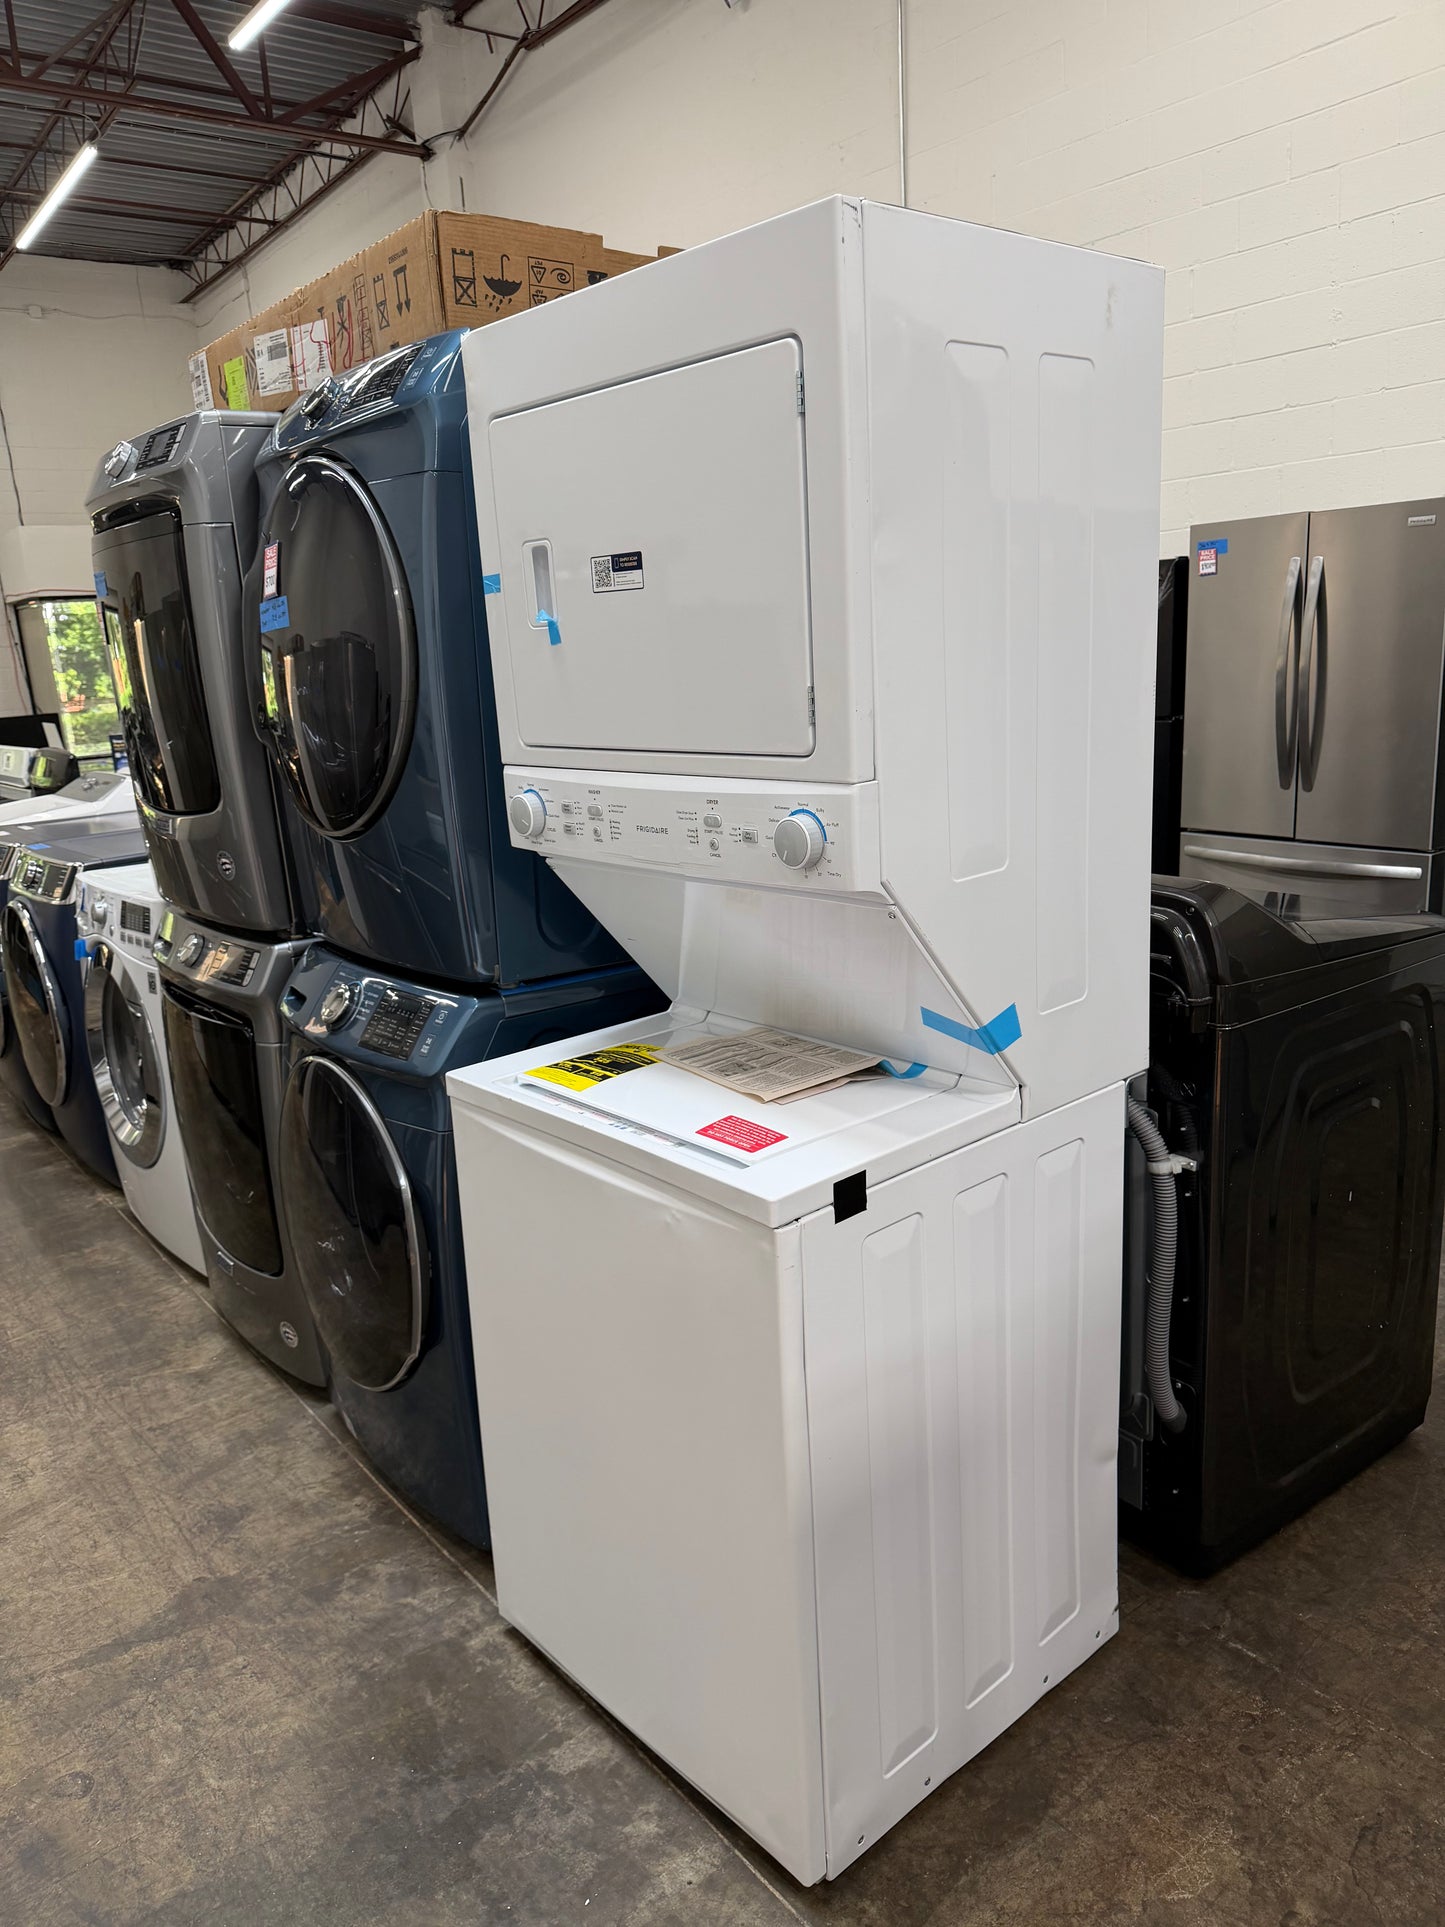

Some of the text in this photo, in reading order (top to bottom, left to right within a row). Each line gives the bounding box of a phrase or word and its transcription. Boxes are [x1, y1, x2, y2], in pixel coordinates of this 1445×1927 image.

[265, 546, 277, 557] SALE
[265, 557, 277, 569] PRICE
[636, 825, 669, 835] FRIGIDAIRE
